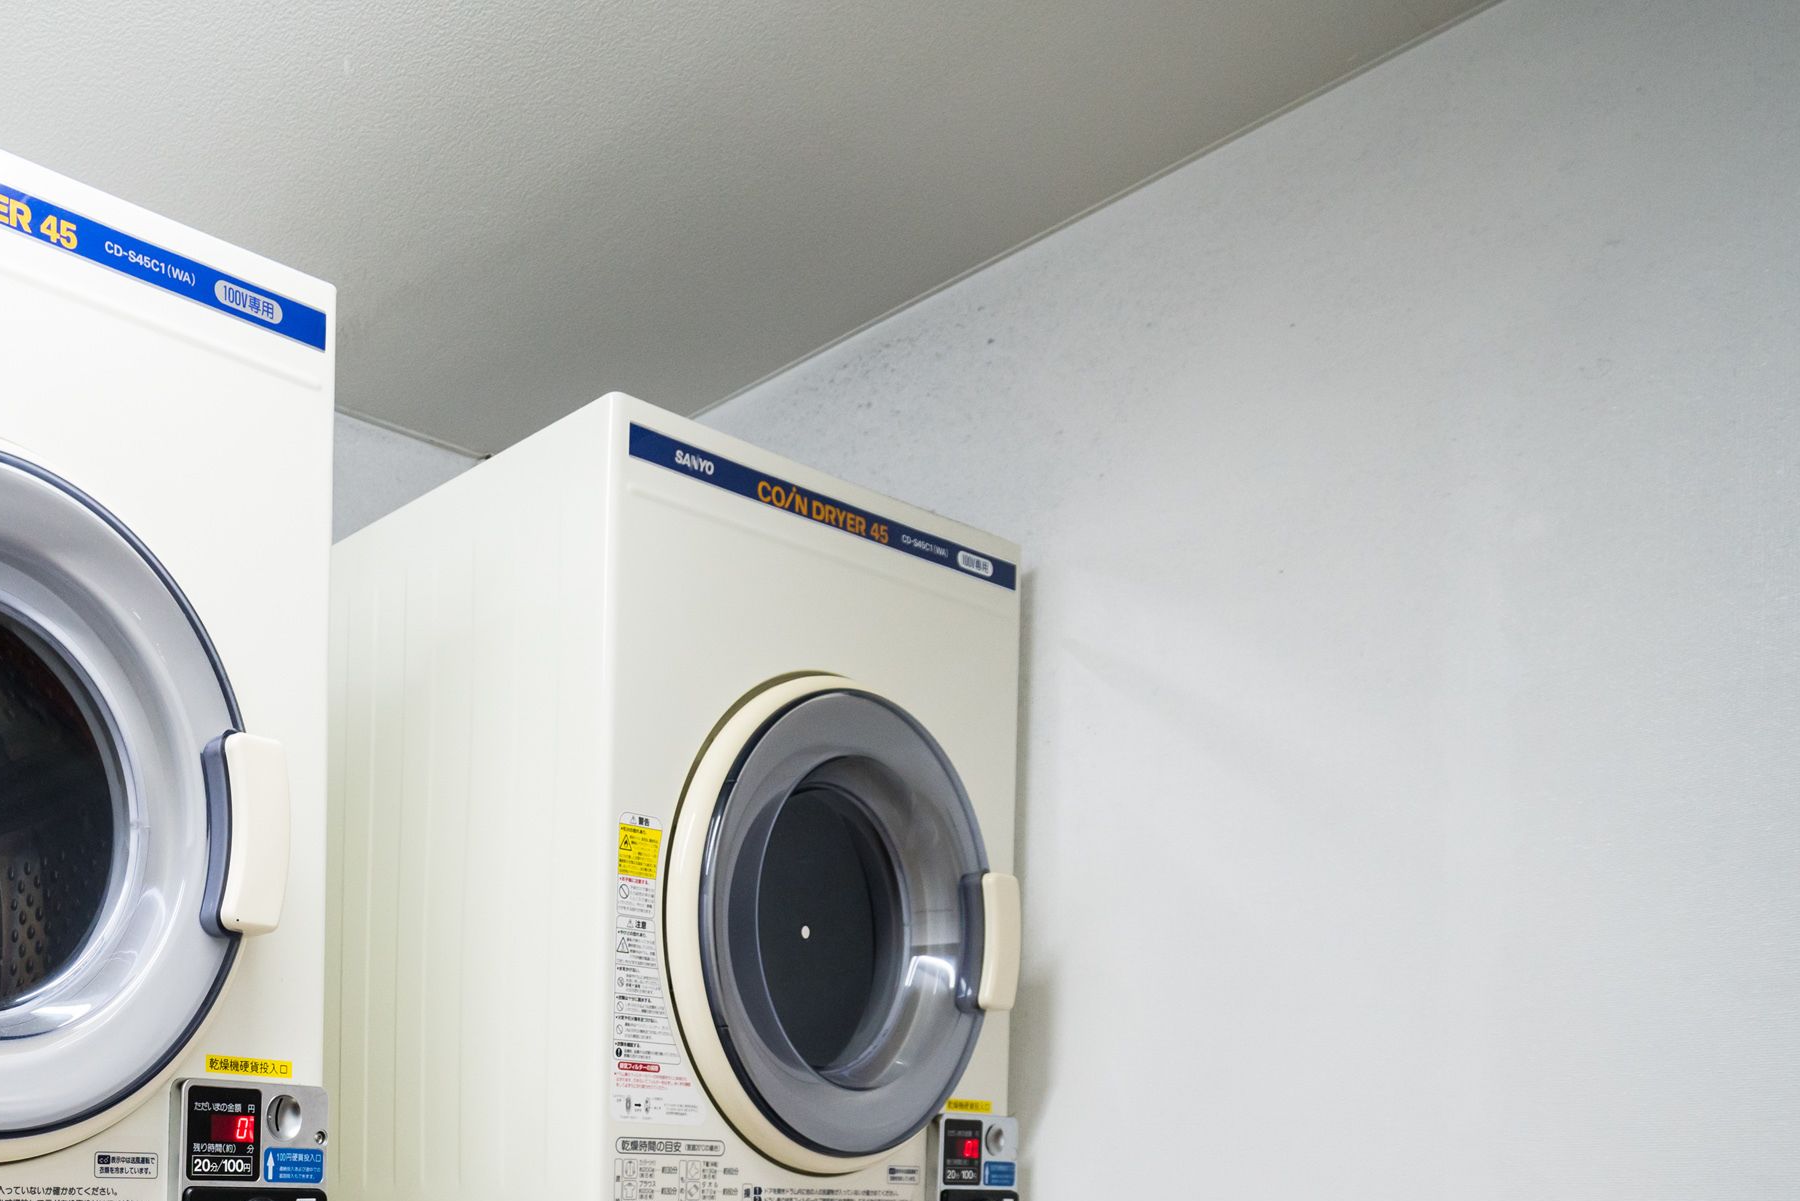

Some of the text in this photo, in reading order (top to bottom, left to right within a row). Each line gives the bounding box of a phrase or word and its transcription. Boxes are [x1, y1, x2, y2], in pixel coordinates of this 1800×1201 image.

[40, 214, 78, 250] 45
[104, 241, 196, 287] CD-S45C1(WA)
[223, 284, 275, 320] 100V専用
[675, 449, 715, 476] SANYO
[812, 499, 867, 537] DRYER
[870, 523, 889, 544] 45
[209, 1058, 288, 1075] 乾燥機硬貨投入口
[247, 1104, 256, 1113] 円
[193, 1143, 255, 1154] 残り時間(約) 分
[621, 1140, 682, 1153] 乾燥時間の目安
[194, 1159, 251, 1172] 20分/100円
[277, 1152, 322, 1163] 100円硬貨投入口
